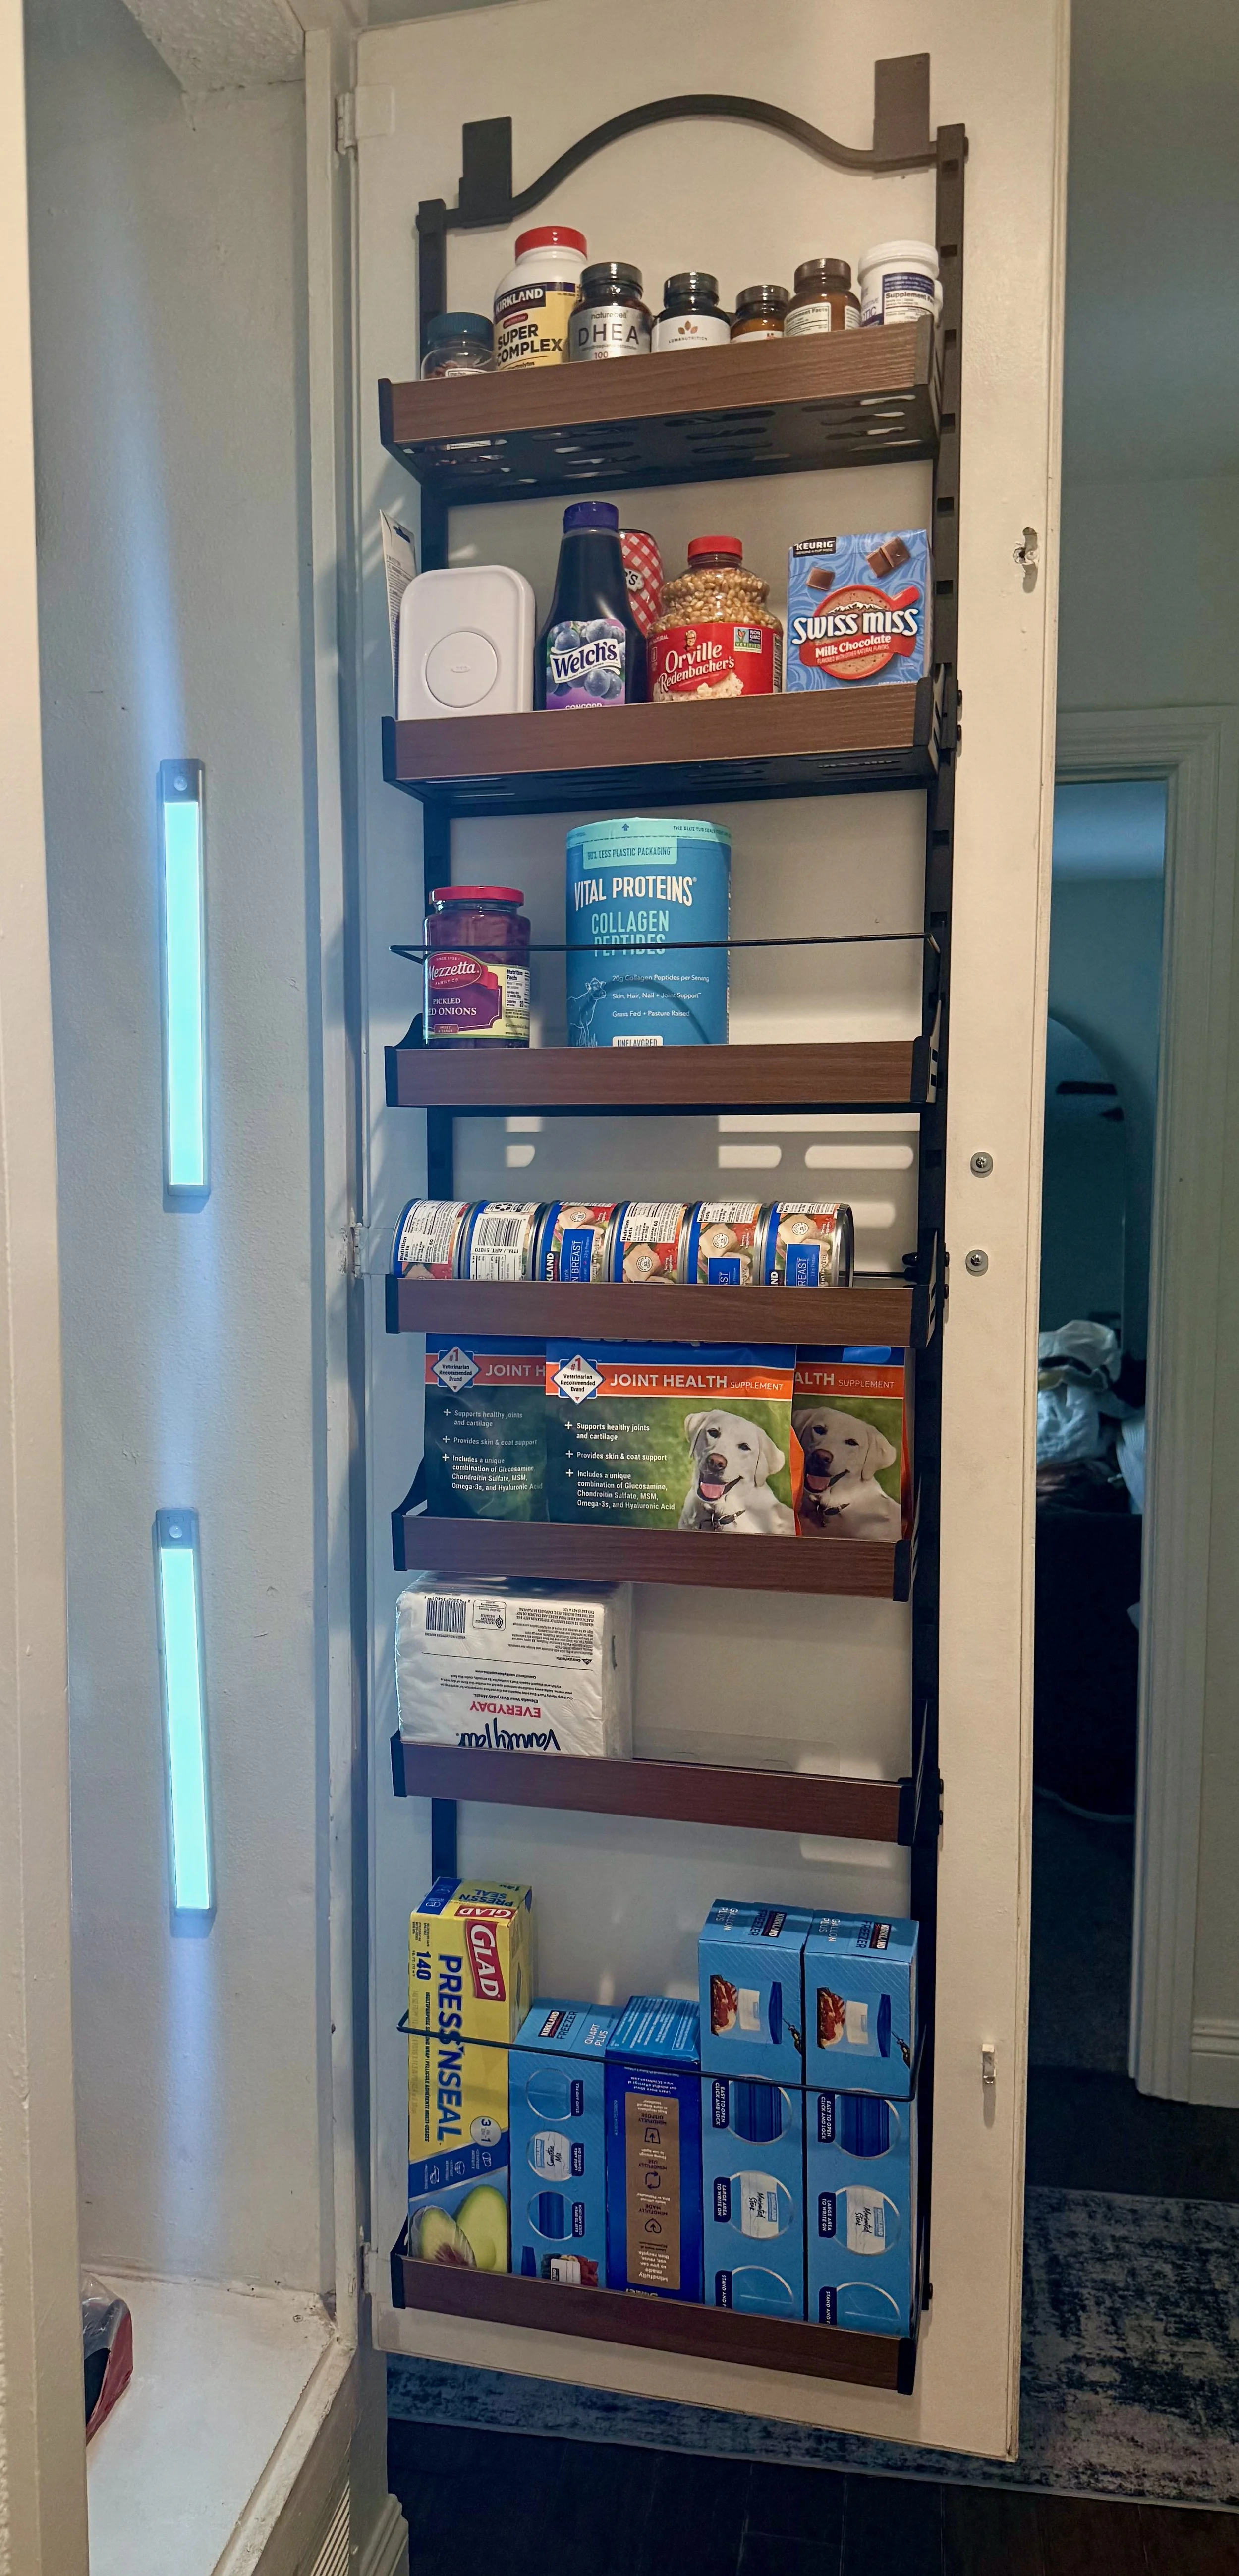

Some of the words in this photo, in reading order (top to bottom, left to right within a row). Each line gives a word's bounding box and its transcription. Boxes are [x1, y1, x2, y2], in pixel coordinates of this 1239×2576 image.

[496, 288, 543, 313] KIRKLAND
[886, 292, 926, 301] Supplement
[498, 324, 539, 350] SUPER
[579, 323, 639, 347] DHEA
[496, 338, 563, 367] COMPLEX
[595, 351, 609, 359] 100
[794, 541, 835, 550] KEURIG
[792, 613, 858, 644] SWISS
[862, 608, 919, 636] MISS
[815, 645, 838, 658] Milk
[839, 634, 891, 653] Chocolate
[553, 641, 618, 678] Welch's
[665, 641, 722, 673] Orville
[659, 656, 734, 693] Redenbacher's
[599, 849, 611, 859] LESS
[613, 848, 635, 857] PLASTIC
[638, 847, 671, 856] PACKAGING
[574, 878, 607, 911] VITAL
[613, 876, 692, 906] PROTEINS
[592, 910, 669, 934] COLLAGEN
[594, 933, 666, 957] PEPTIDES
[438, 1007, 477, 1016] ONIONS
[572, 1240, 581, 1274] BREAST
[798, 1257, 807, 1286] REAST
[449, 1348, 459, 1362] #1
[570, 1357, 581, 1371] #1
[486, 1364, 531, 1377] JOINT
[610, 1373, 659, 1387] JOINT
[663, 1374, 728, 1388] HEALTH
[730, 1380, 784, 1391] SUPPLEMENT
[794, 1371, 835, 1386] ALTH
[838, 1379, 895, 1389] SUPPLEMENT
[466, 1420, 493, 1428] cartilage
[576, 1422, 606, 1431] Supports
[607, 1423, 630, 1433] healthy
[631, 1424, 650, 1433] joints
[589, 1433, 618, 1442] cartilage
[577, 1470, 603, 1478] Includes
[610, 1472, 631, 1481] unique
[451, 1483, 484, 1491] Omega-3s,
[498, 1483, 528, 1492] Hyaluronic
[577, 1490, 613, 1498] Chondroitin
[614, 1492, 639, 1501] Sulfate,
[624, 1482, 668, 1492] Glucosamine,
[577, 1499, 611, 1509] Omega-3s,
[469, 1701, 541, 1718] EVERYDAY
[459, 1894, 514, 1907] PRESS'N
[475, 1889, 507, 1900] SEAL
[459, 1908, 512, 1918] GLAD
[716, 1907, 729, 1921] PLUS
[723, 1907, 738, 1931] GALLON
[748, 1909, 768, 1936] FREEZER
[769, 1913, 786, 1937] KIRKLAND
[819, 1917, 830, 1932] PLUS
[828, 1918, 840, 1942] GALLON
[855, 1920, 873, 1949] FREEZER
[877, 1924, 890, 1949] KIRKLAND
[416, 1951, 431, 1980] 140
[470, 1924, 501, 1997] GLAD
[540, 2011, 560, 2036] KIRKLAND
[556, 2011, 578, 2039] FREEZER
[585, 2024, 600, 2044] QUART
[594, 2030, 608, 2046] PLUS
[717, 2208, 722, 2216] ON
[822, 2223, 827, 2231] ON
[639, 2272, 668, 2282] Mindfully
